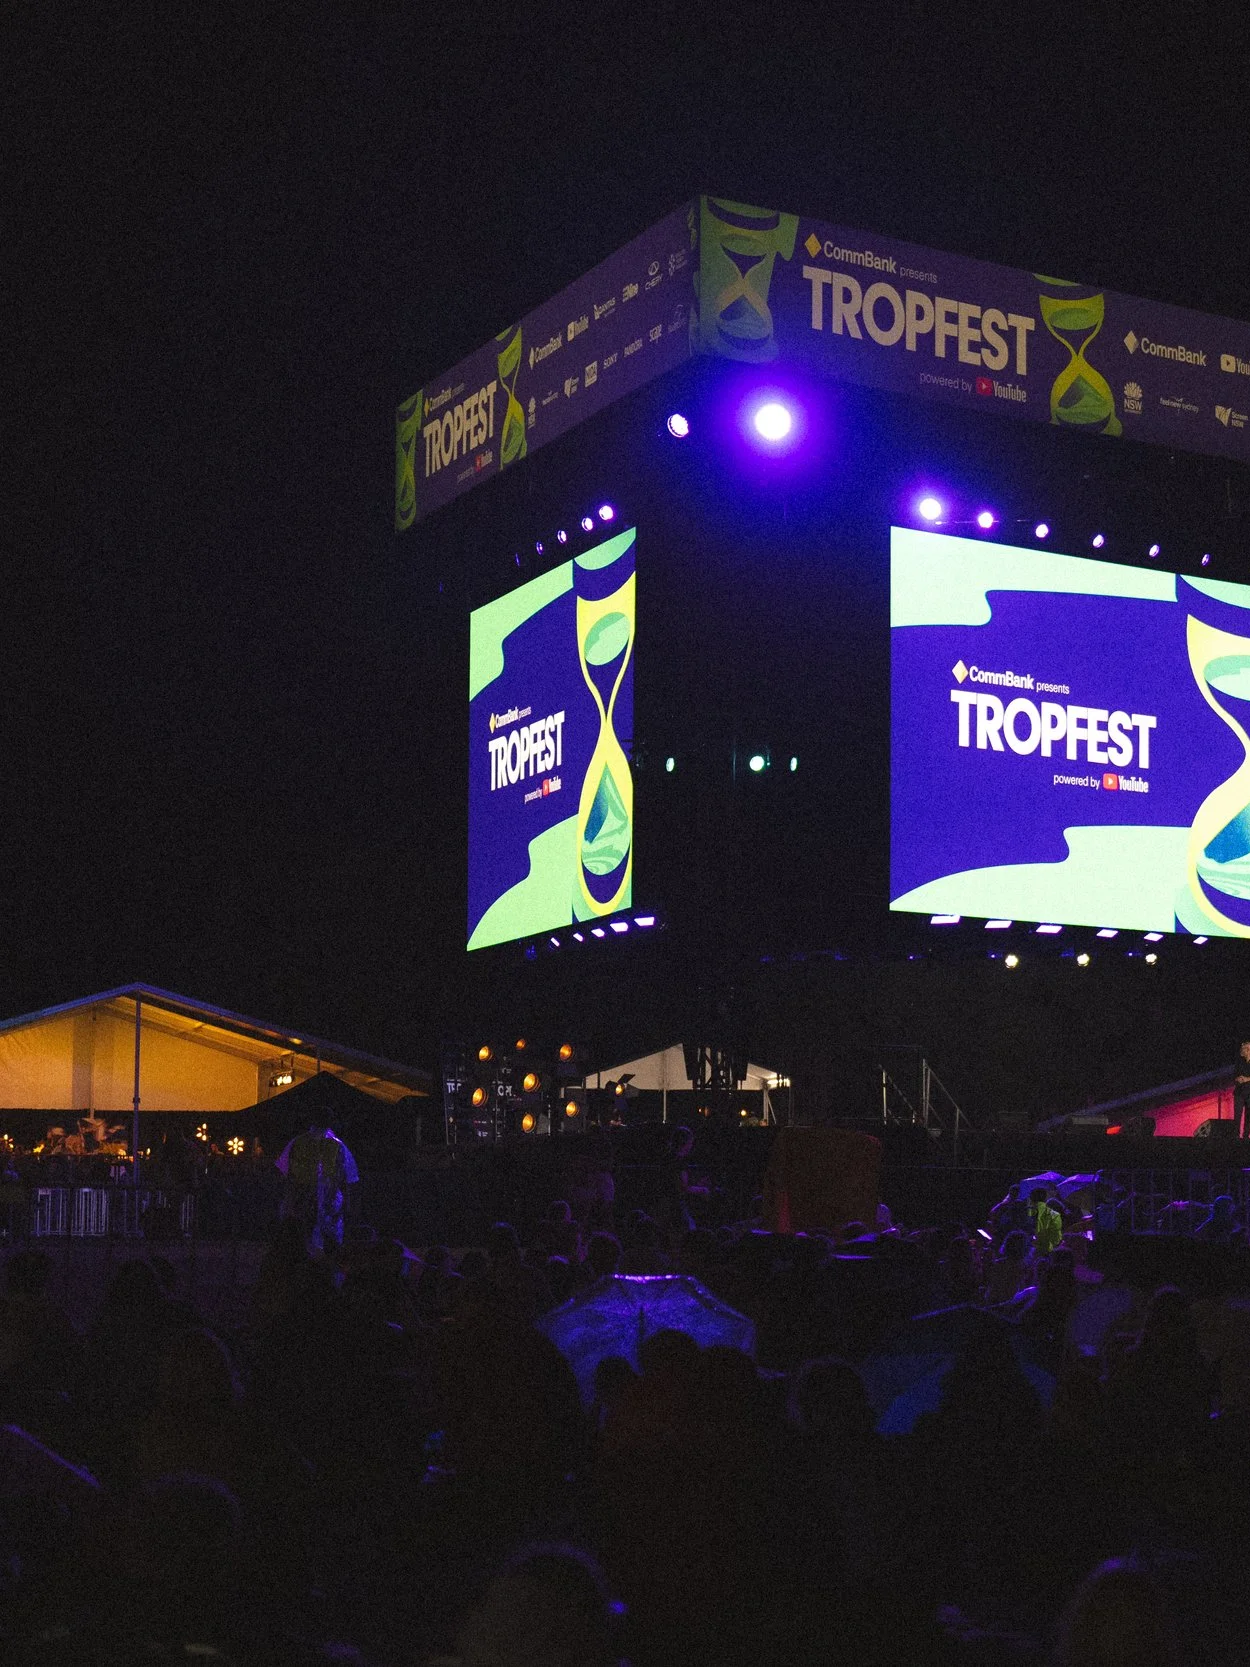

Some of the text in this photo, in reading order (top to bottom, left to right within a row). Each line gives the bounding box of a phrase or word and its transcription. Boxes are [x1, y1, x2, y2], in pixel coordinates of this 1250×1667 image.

[823, 240, 938, 285] CommBank presents
[802, 265, 1036, 376] TROPFEST
[1141, 337, 1207, 367] CommBank
[919, 372, 1028, 403] powered by YouTube
[1123, 398, 1143, 412] NSW
[423, 380, 497, 477] TROPFEST
[969, 665, 1070, 695] CommBank presents
[950, 689, 1157, 769] TROPFEST
[488, 710, 565, 791] TROPFEST
[1053, 774, 1149, 793] powered by YouTube
